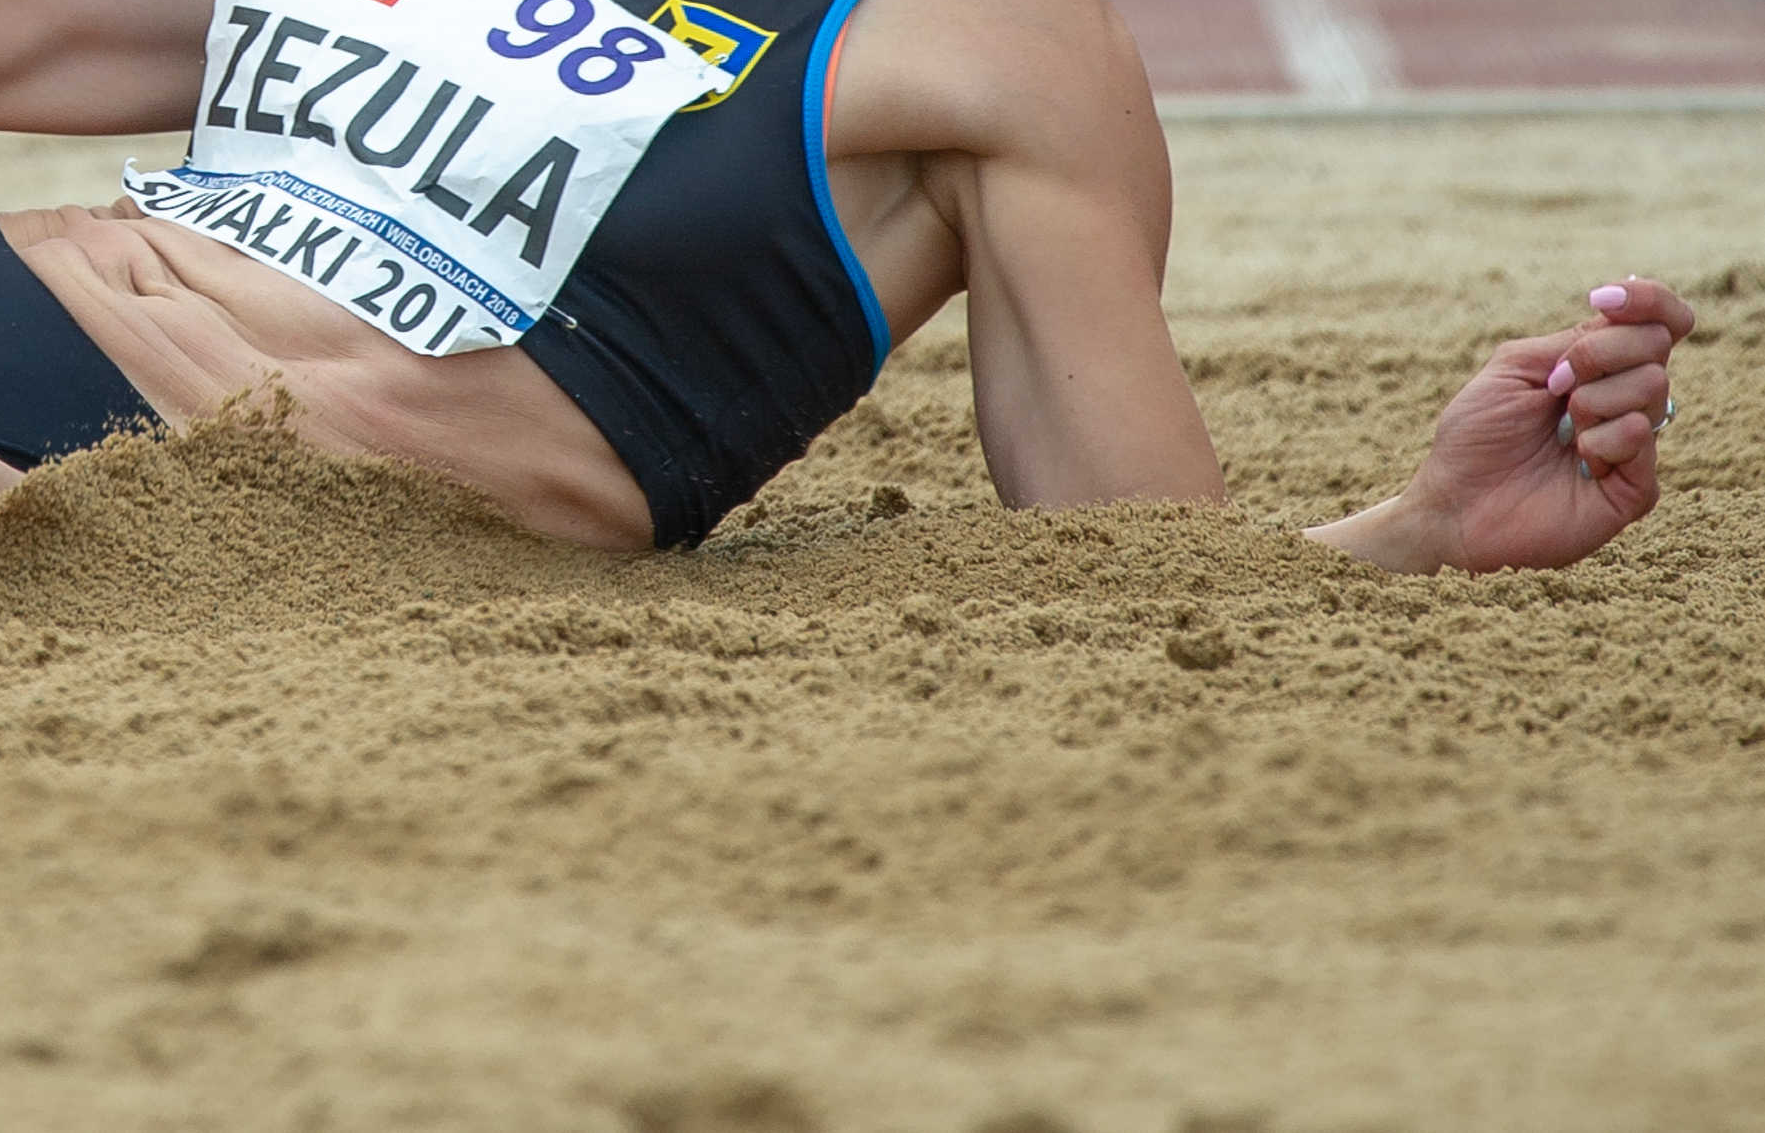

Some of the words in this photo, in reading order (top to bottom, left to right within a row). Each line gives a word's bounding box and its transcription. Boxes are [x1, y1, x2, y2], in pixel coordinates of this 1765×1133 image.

[206, 4, 580, 270] ZEZULA
[124, 178, 363, 287] SUWAŁKI
[351, 259, 502, 352] 201
[301, 186, 383, 230] SZTAFETACH
[385, 222, 491, 303] WIELOBOJACH
[484, 293, 521, 327] 2018
